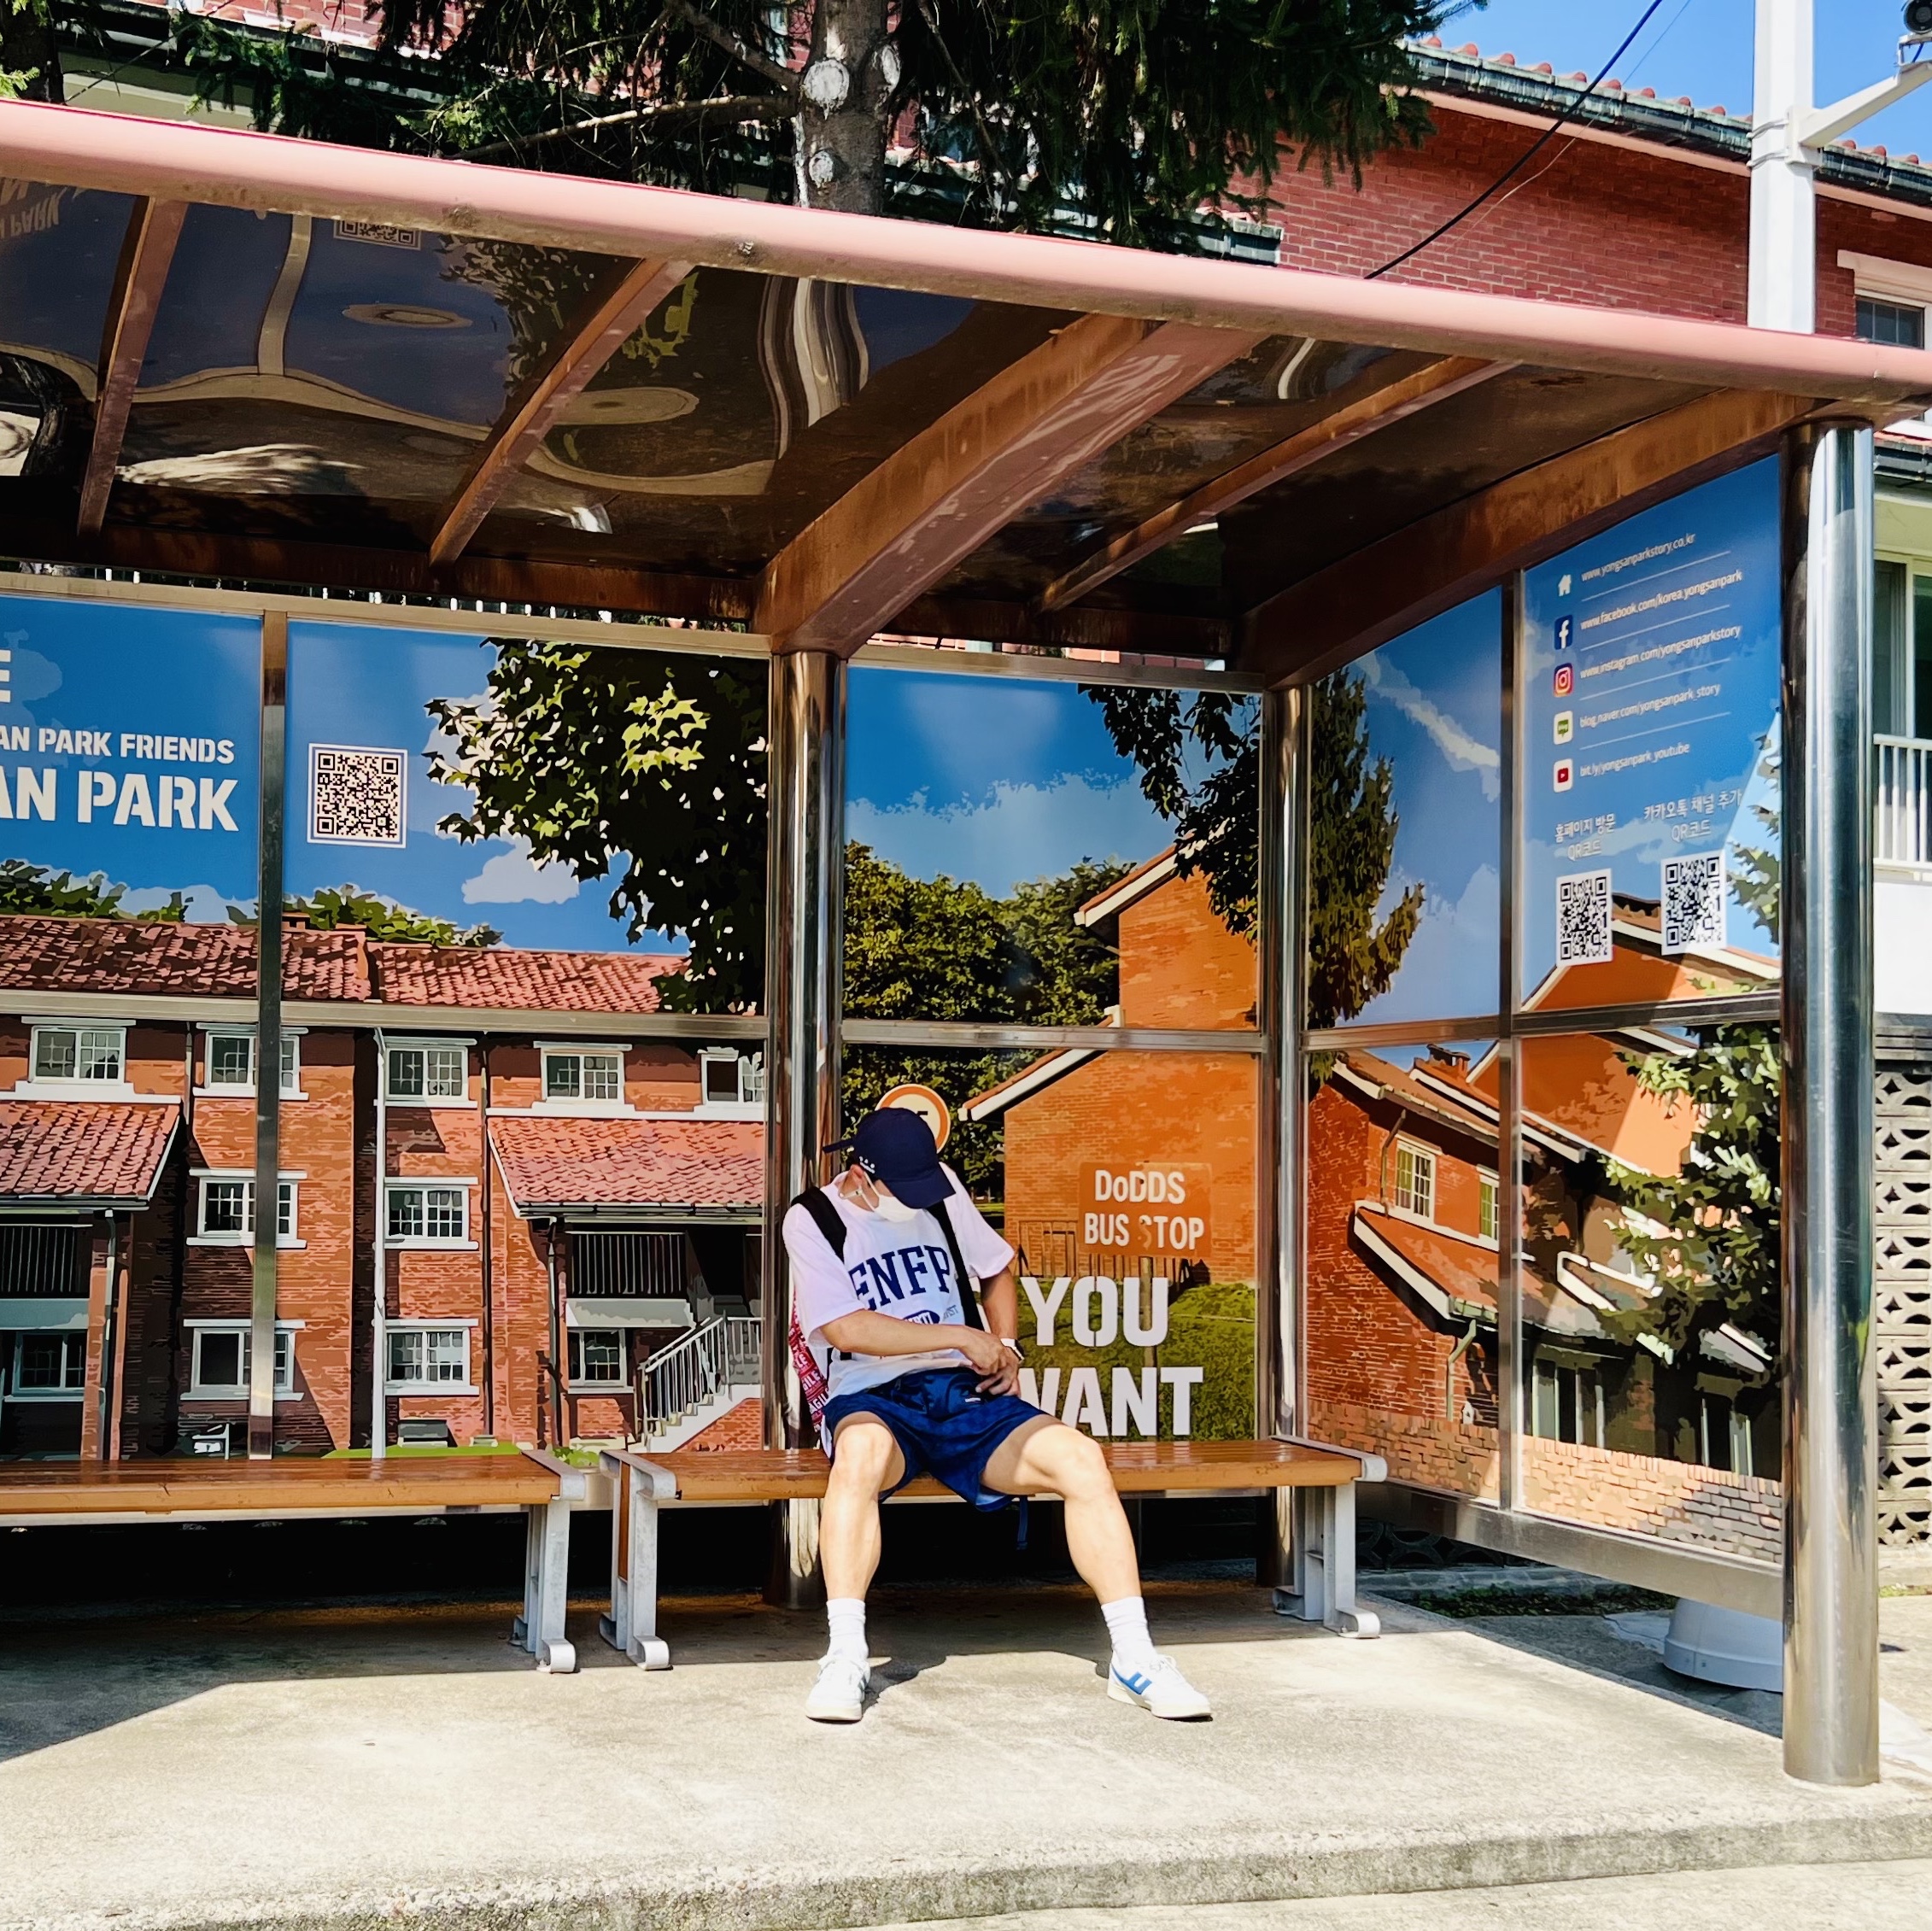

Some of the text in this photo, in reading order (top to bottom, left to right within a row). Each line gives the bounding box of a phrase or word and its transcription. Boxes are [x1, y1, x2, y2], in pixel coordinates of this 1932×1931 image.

[1581, 533, 1696, 582] www.yongsanparkstory.co.kr
[1580, 625, 1742, 679] www.instagram.com/yongsanparkstory
[1580, 684, 1720, 728] blog.naver.com/yongsanpark_story
[38, 728, 112, 757] PARK
[120, 733, 235, 764] FRIENDS
[78, 770, 239, 832] PARK
[1643, 787, 1743, 822] 카카오톡 채널 추가
[1554, 813, 1616, 844] 홈페이지 방문
[1671, 819, 1712, 843] QR코드
[1567, 839, 1602, 862] QR코드
[1095, 1169, 1186, 1204] DoDDS
[1085, 1212, 1205, 1251] BUS STOP
[848, 1244, 951, 1311] ENFP
[1020, 1276, 1168, 1348] YOU
